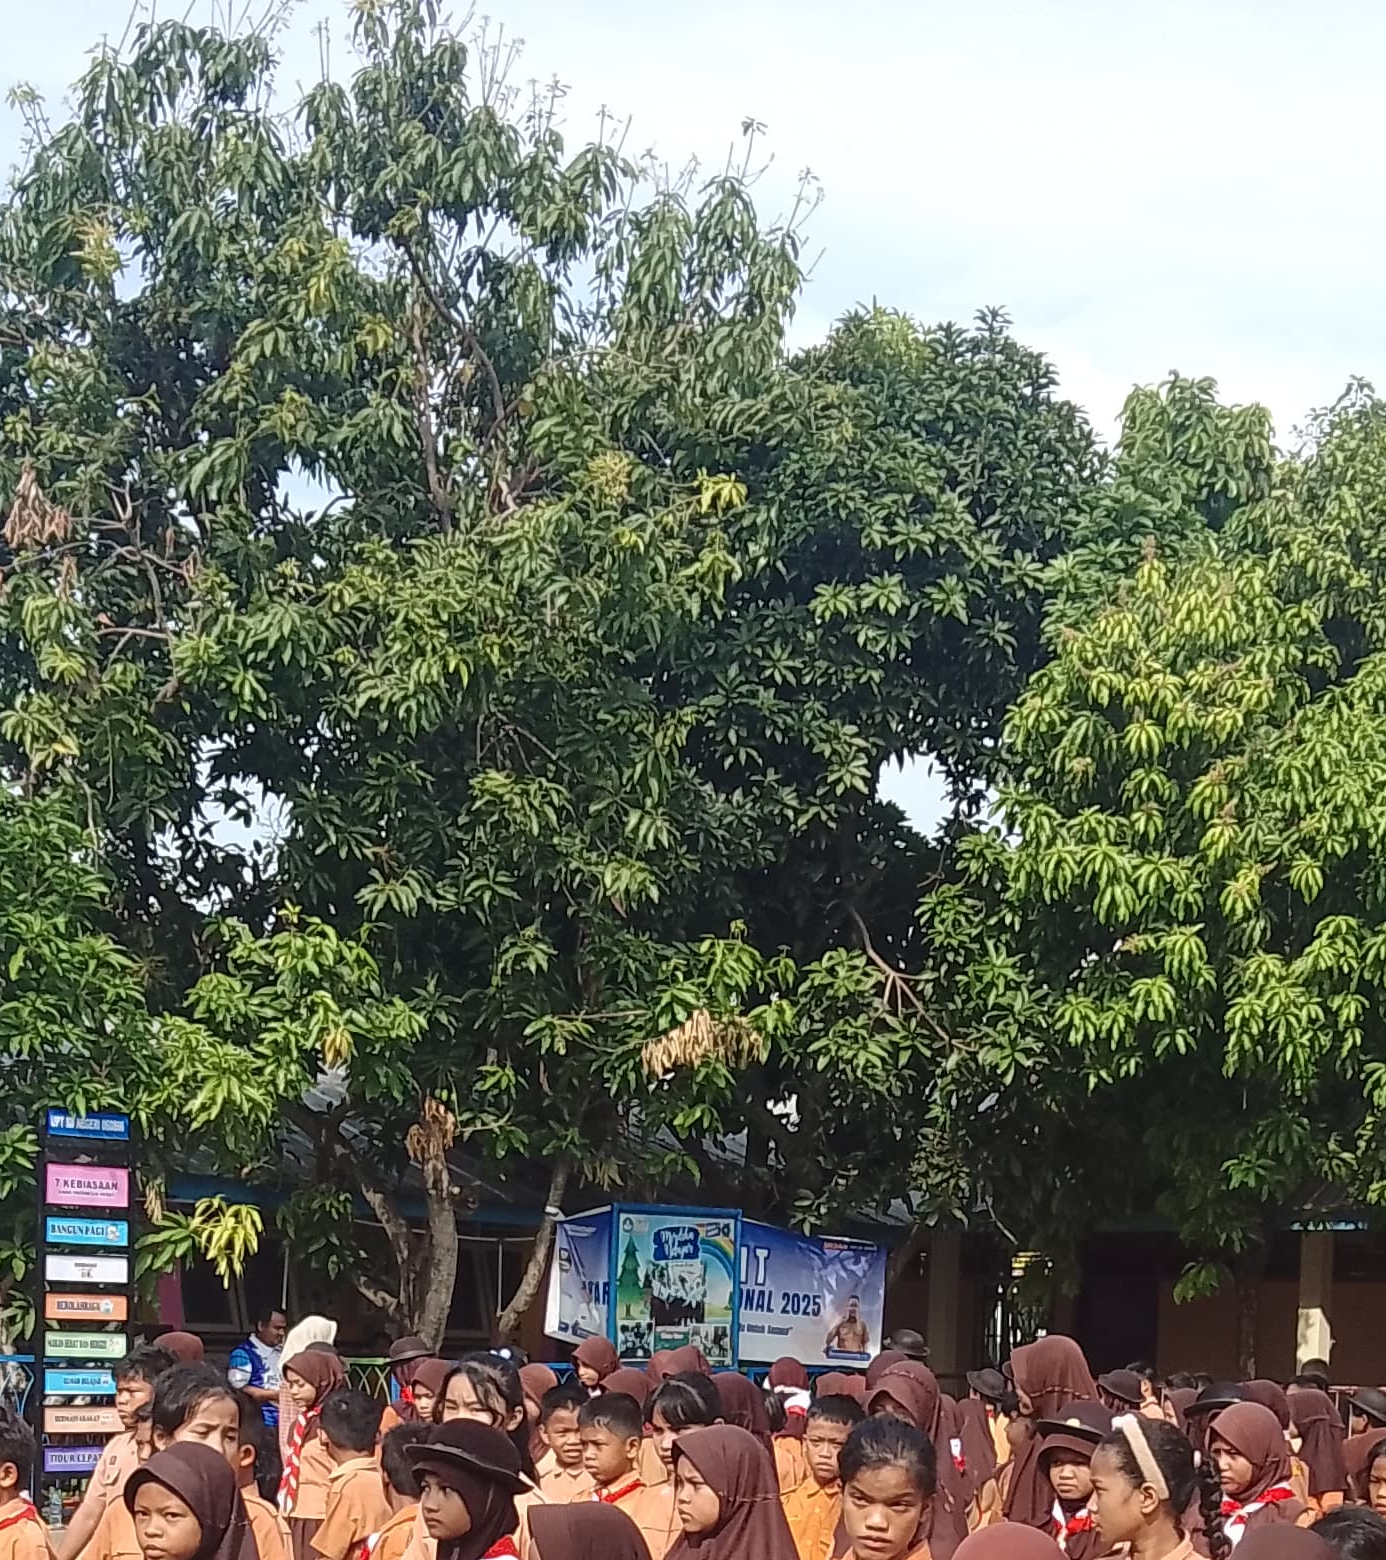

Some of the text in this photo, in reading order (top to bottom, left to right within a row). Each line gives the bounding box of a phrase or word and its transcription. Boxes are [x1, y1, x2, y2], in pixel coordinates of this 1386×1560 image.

[55, 1178, 118, 1191] 7 KEBIASAAN
[740, 1288, 822, 1317] NAL 2025
